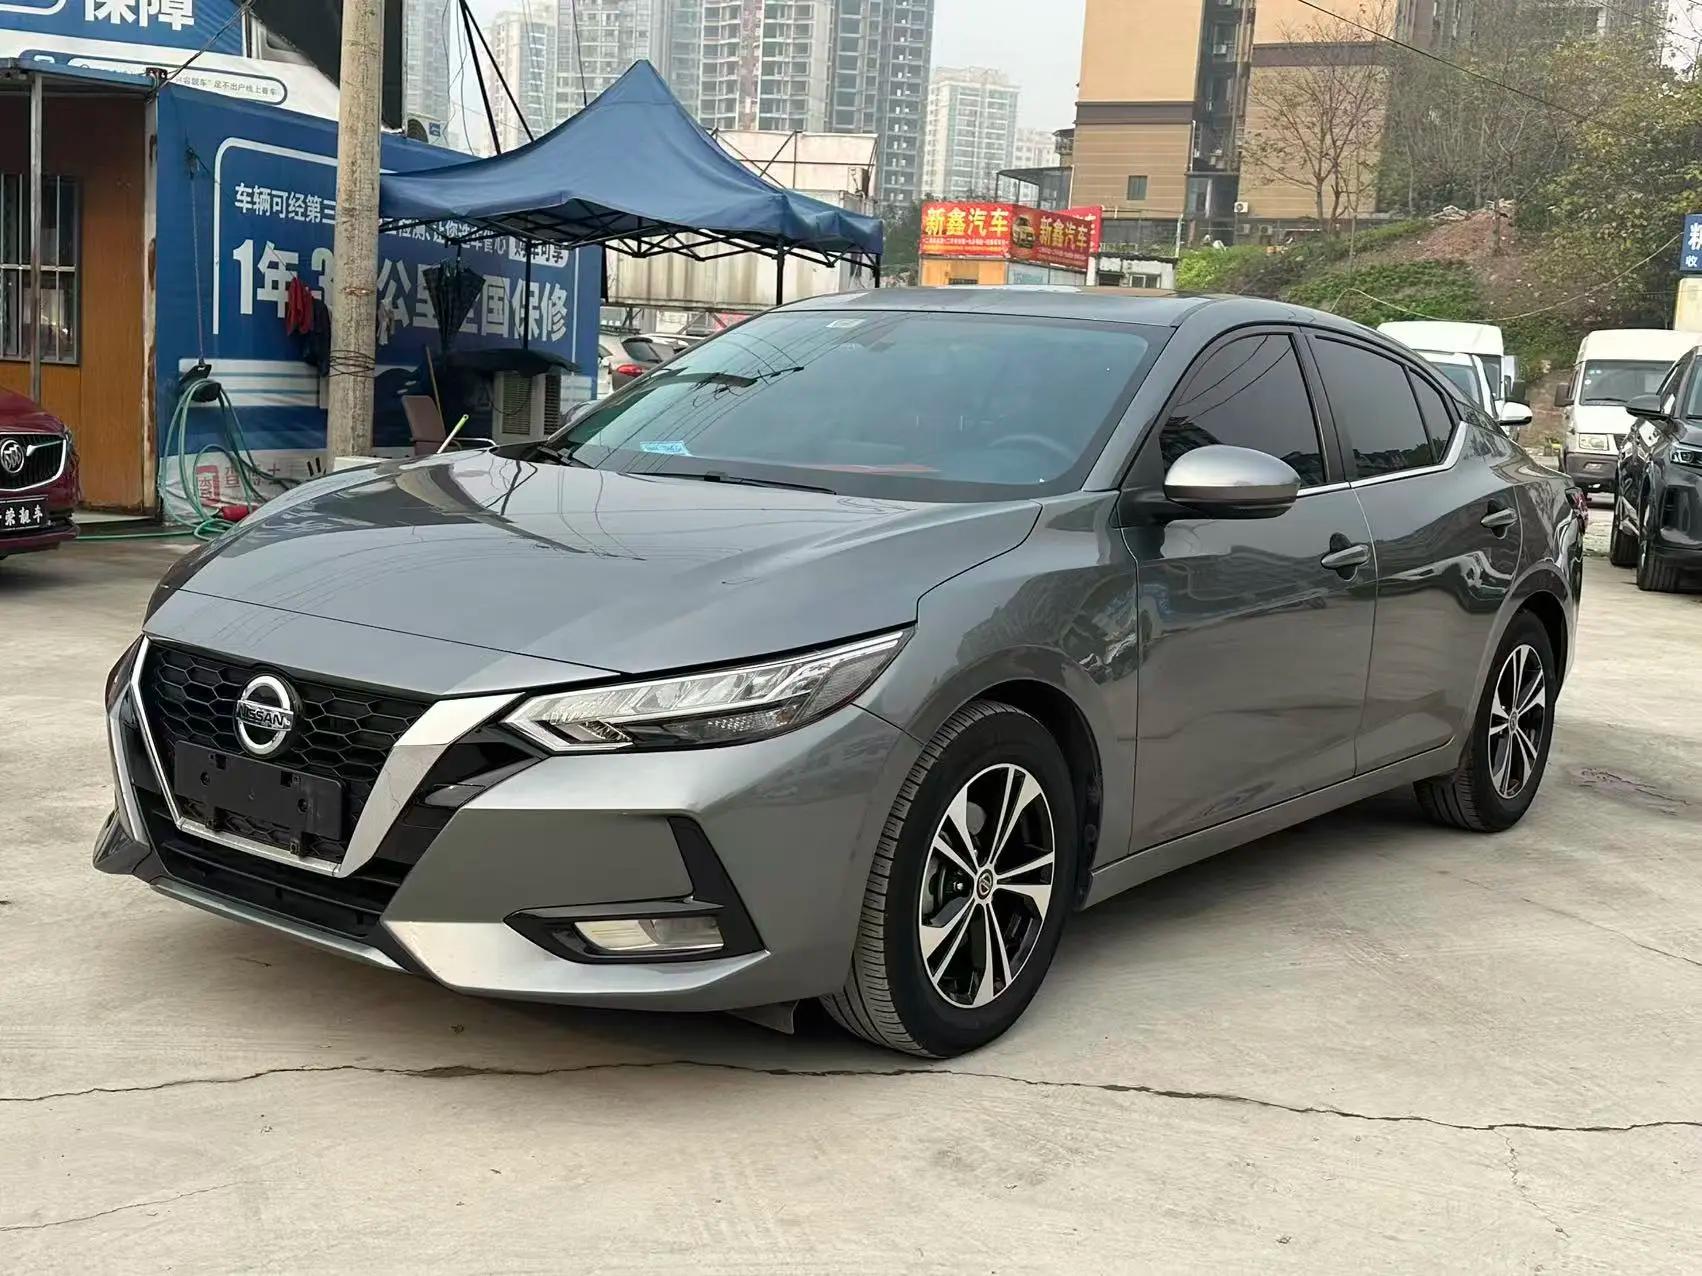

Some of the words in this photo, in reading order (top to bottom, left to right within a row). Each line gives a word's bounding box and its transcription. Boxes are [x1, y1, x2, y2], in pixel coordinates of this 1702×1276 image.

[925, 207, 1009, 237] 新鑫汽车
[1039, 215, 1089, 252] 新鑫汽车
[239, 702, 285, 727] NISSAN
